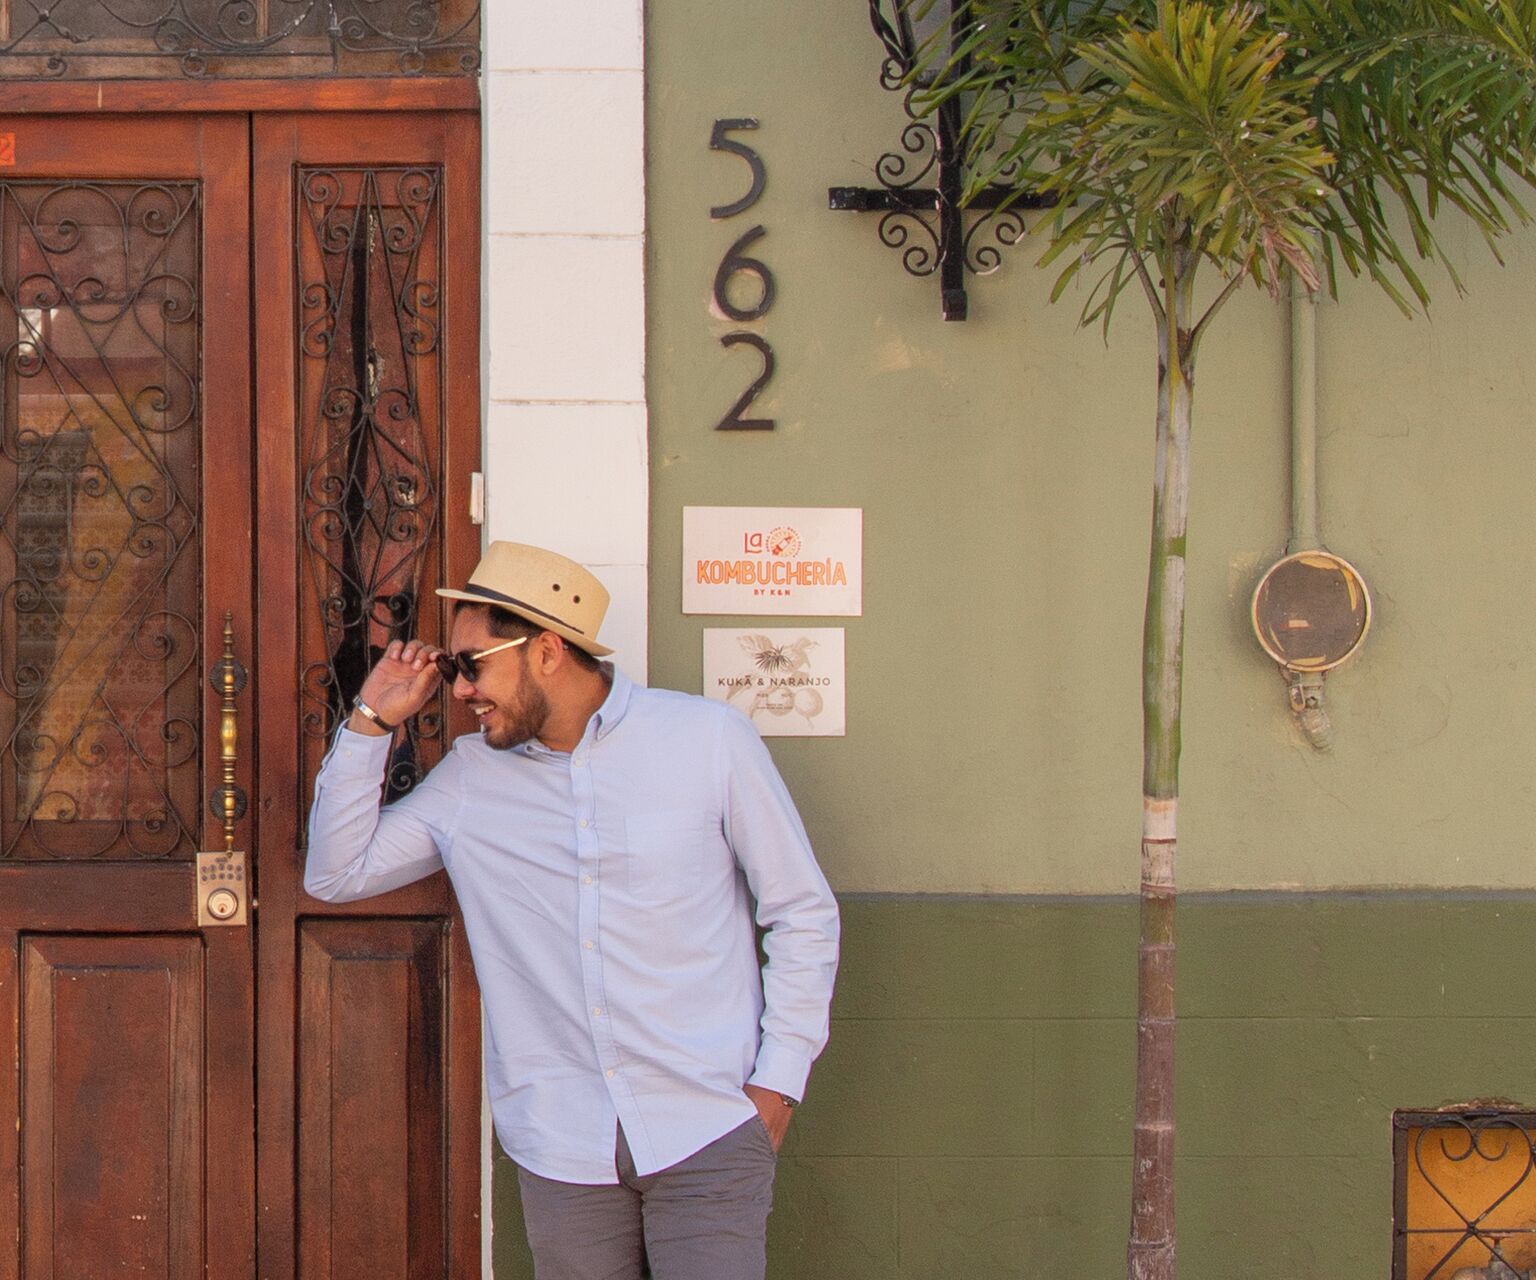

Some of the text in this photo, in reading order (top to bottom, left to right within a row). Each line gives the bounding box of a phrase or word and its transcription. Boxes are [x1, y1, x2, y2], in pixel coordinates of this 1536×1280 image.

[709, 117, 776, 432] 562
[696, 558, 847, 586] KOMBUCHERÍA
[757, 678, 764, 686] &
[770, 677, 831, 687] NARANJO
